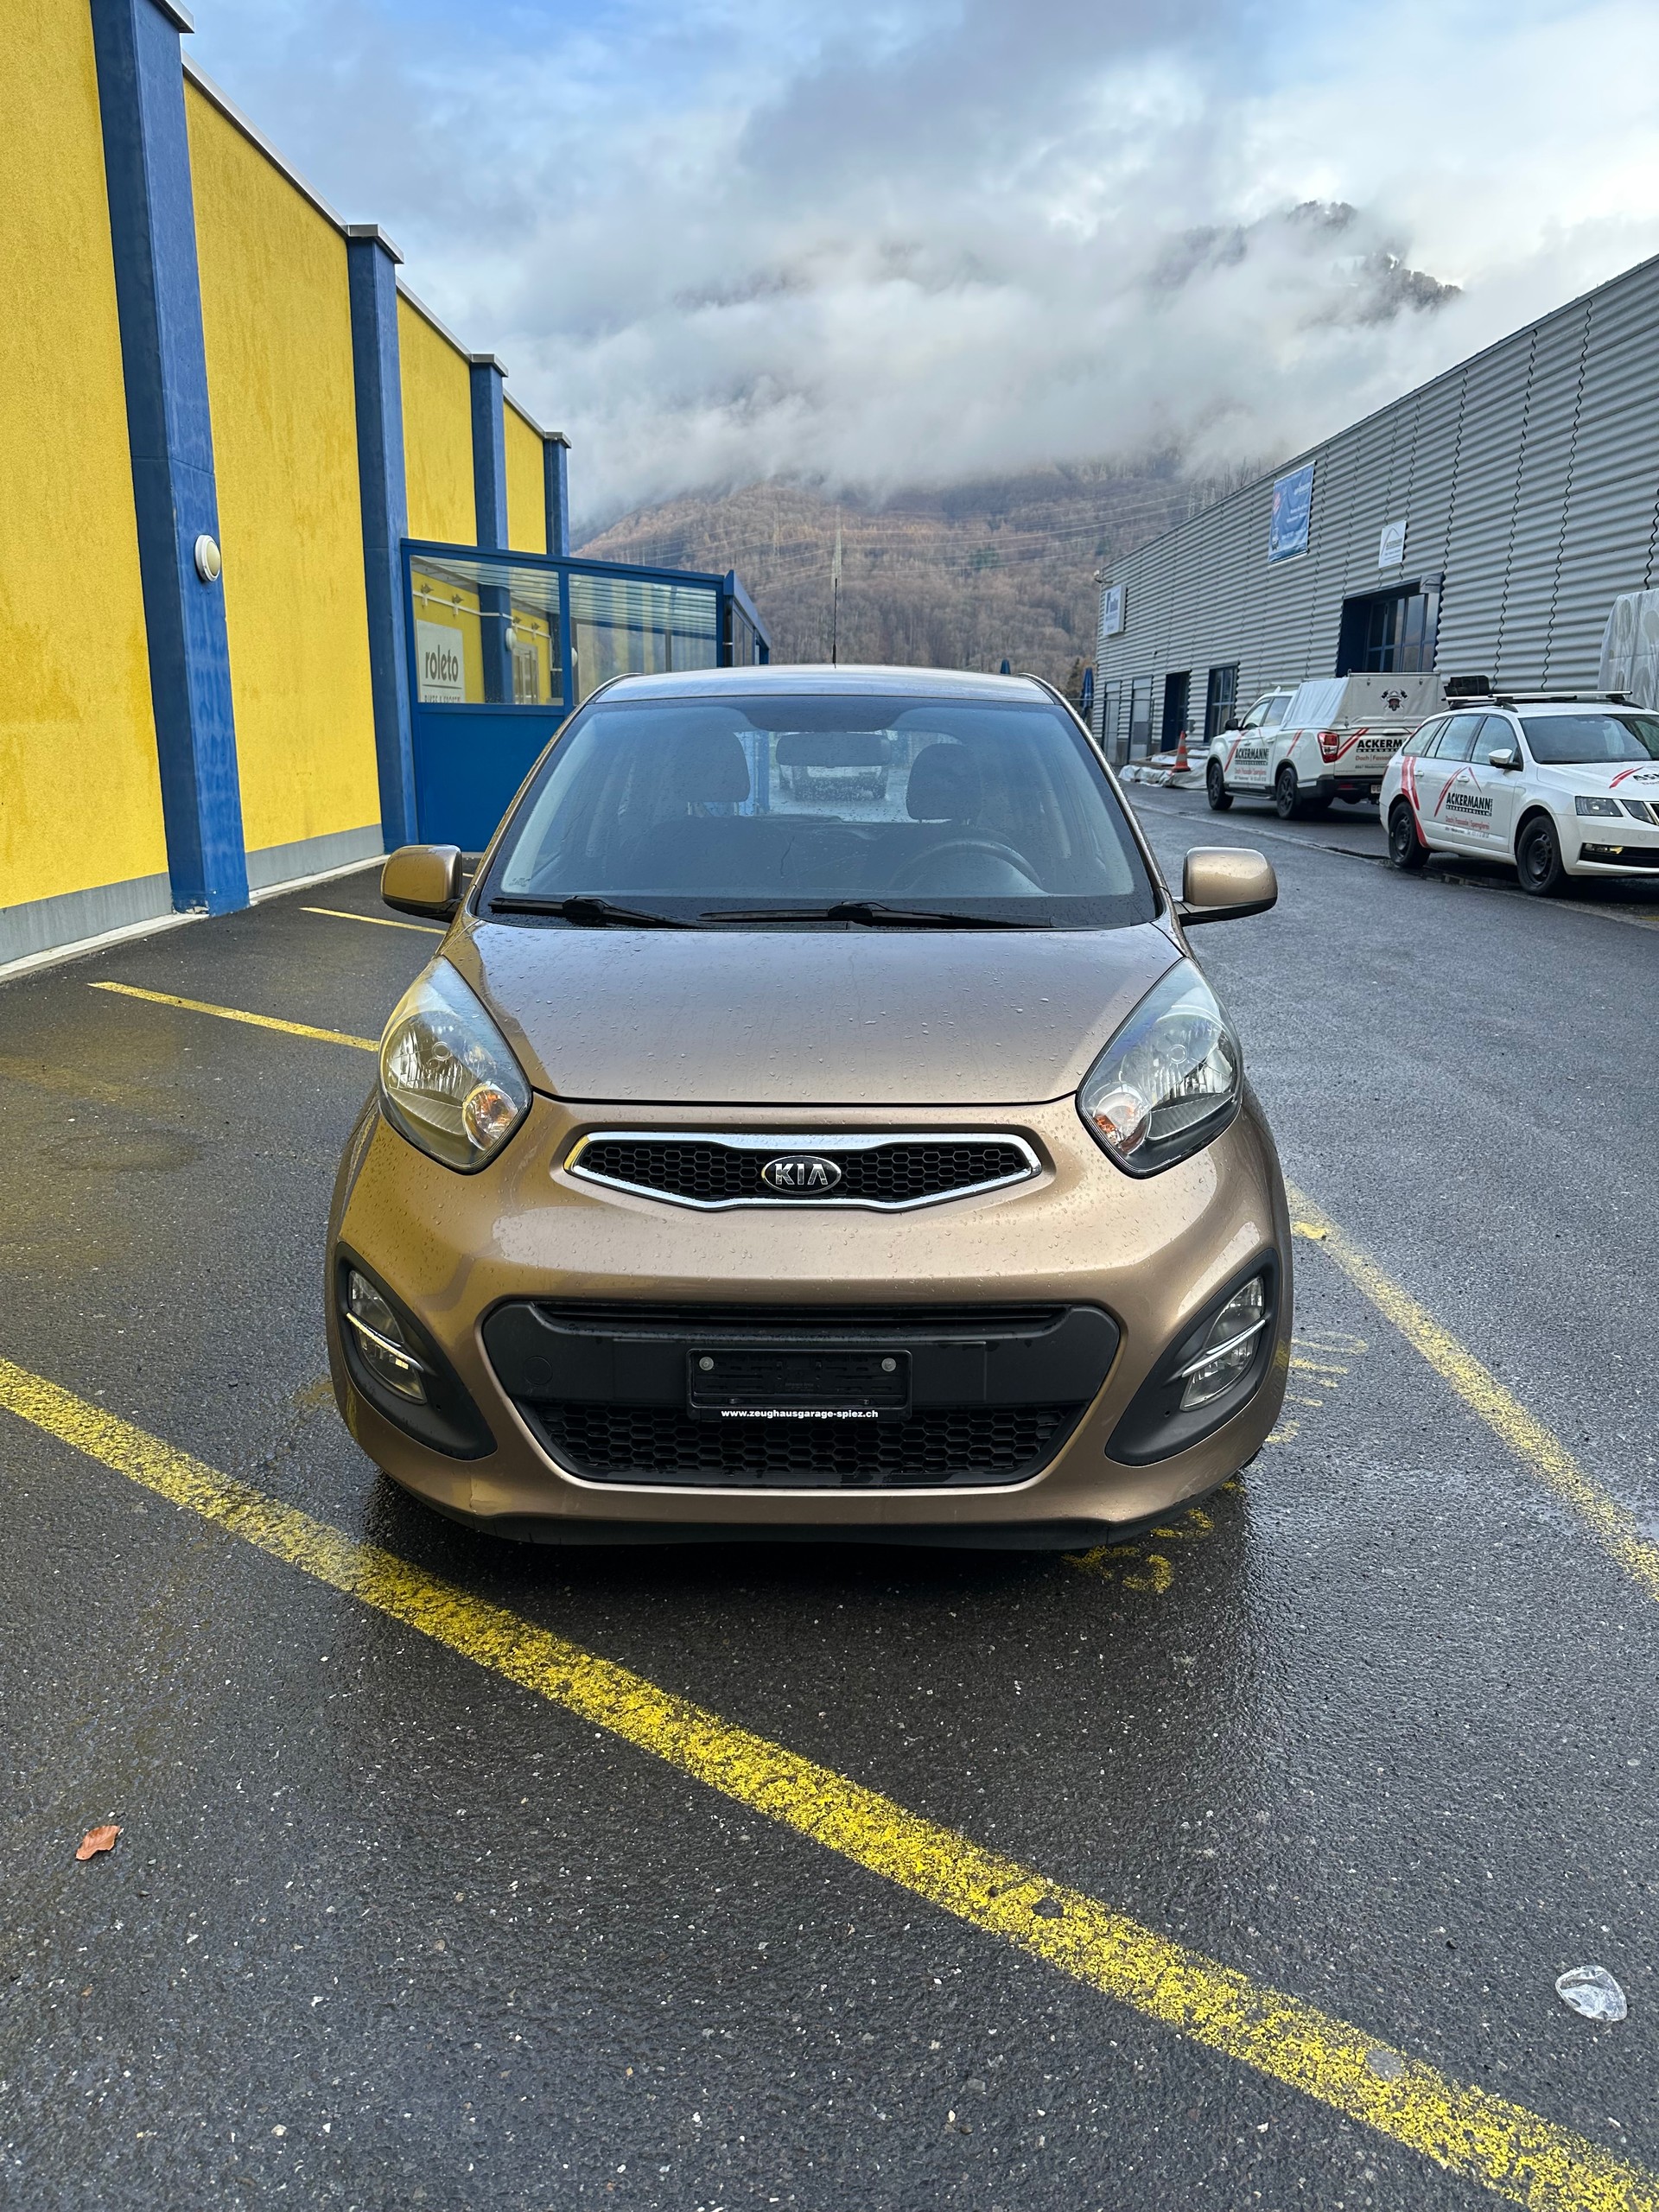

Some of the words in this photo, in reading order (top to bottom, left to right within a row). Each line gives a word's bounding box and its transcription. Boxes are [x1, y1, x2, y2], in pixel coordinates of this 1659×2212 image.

[425, 644, 459, 683] roleto
[1357, 739, 1405, 748] ACKERM
[1446, 792, 1491, 810] ACKERMANN
[774, 1163, 829, 1185] KIA
[721, 1409, 879, 1419] www.zeughausgarage-spiez.ch
